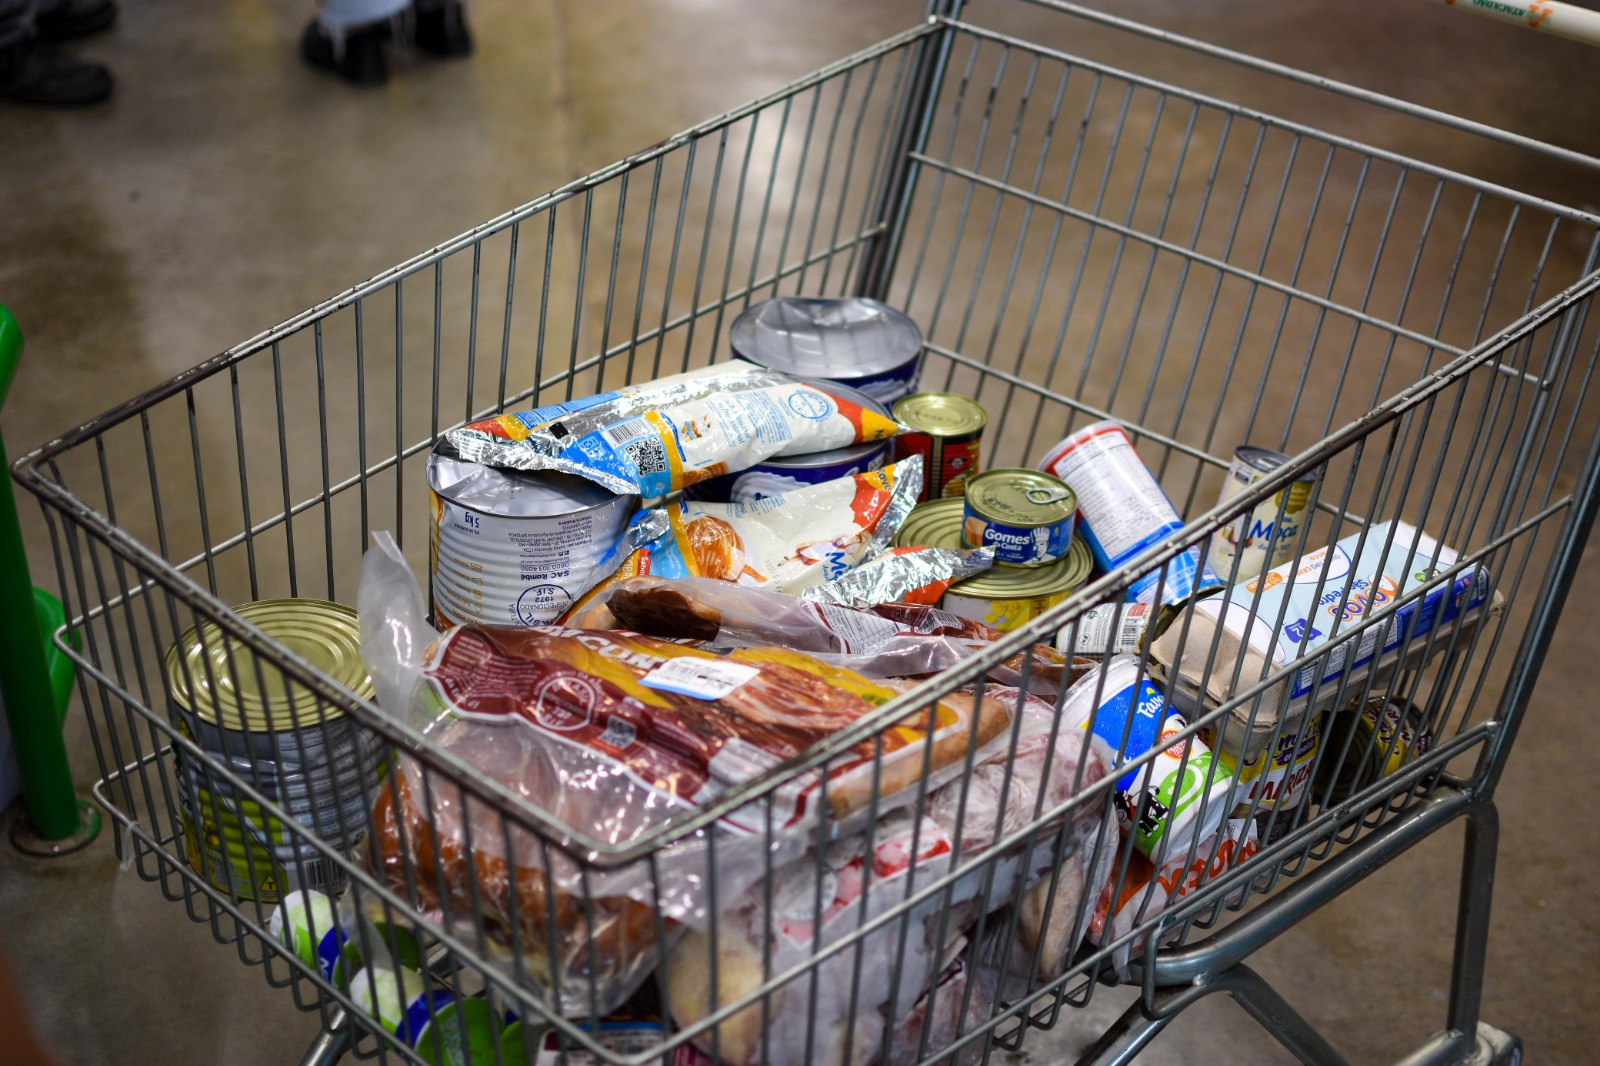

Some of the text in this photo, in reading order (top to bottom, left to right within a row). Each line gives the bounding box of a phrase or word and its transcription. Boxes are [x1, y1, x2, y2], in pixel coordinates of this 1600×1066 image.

[464, 512, 480, 528] 5 kg
[984, 528, 1031, 545] Gomes
[1000, 541, 1022, 551] Costa
[551, 570, 570, 579] SAC
